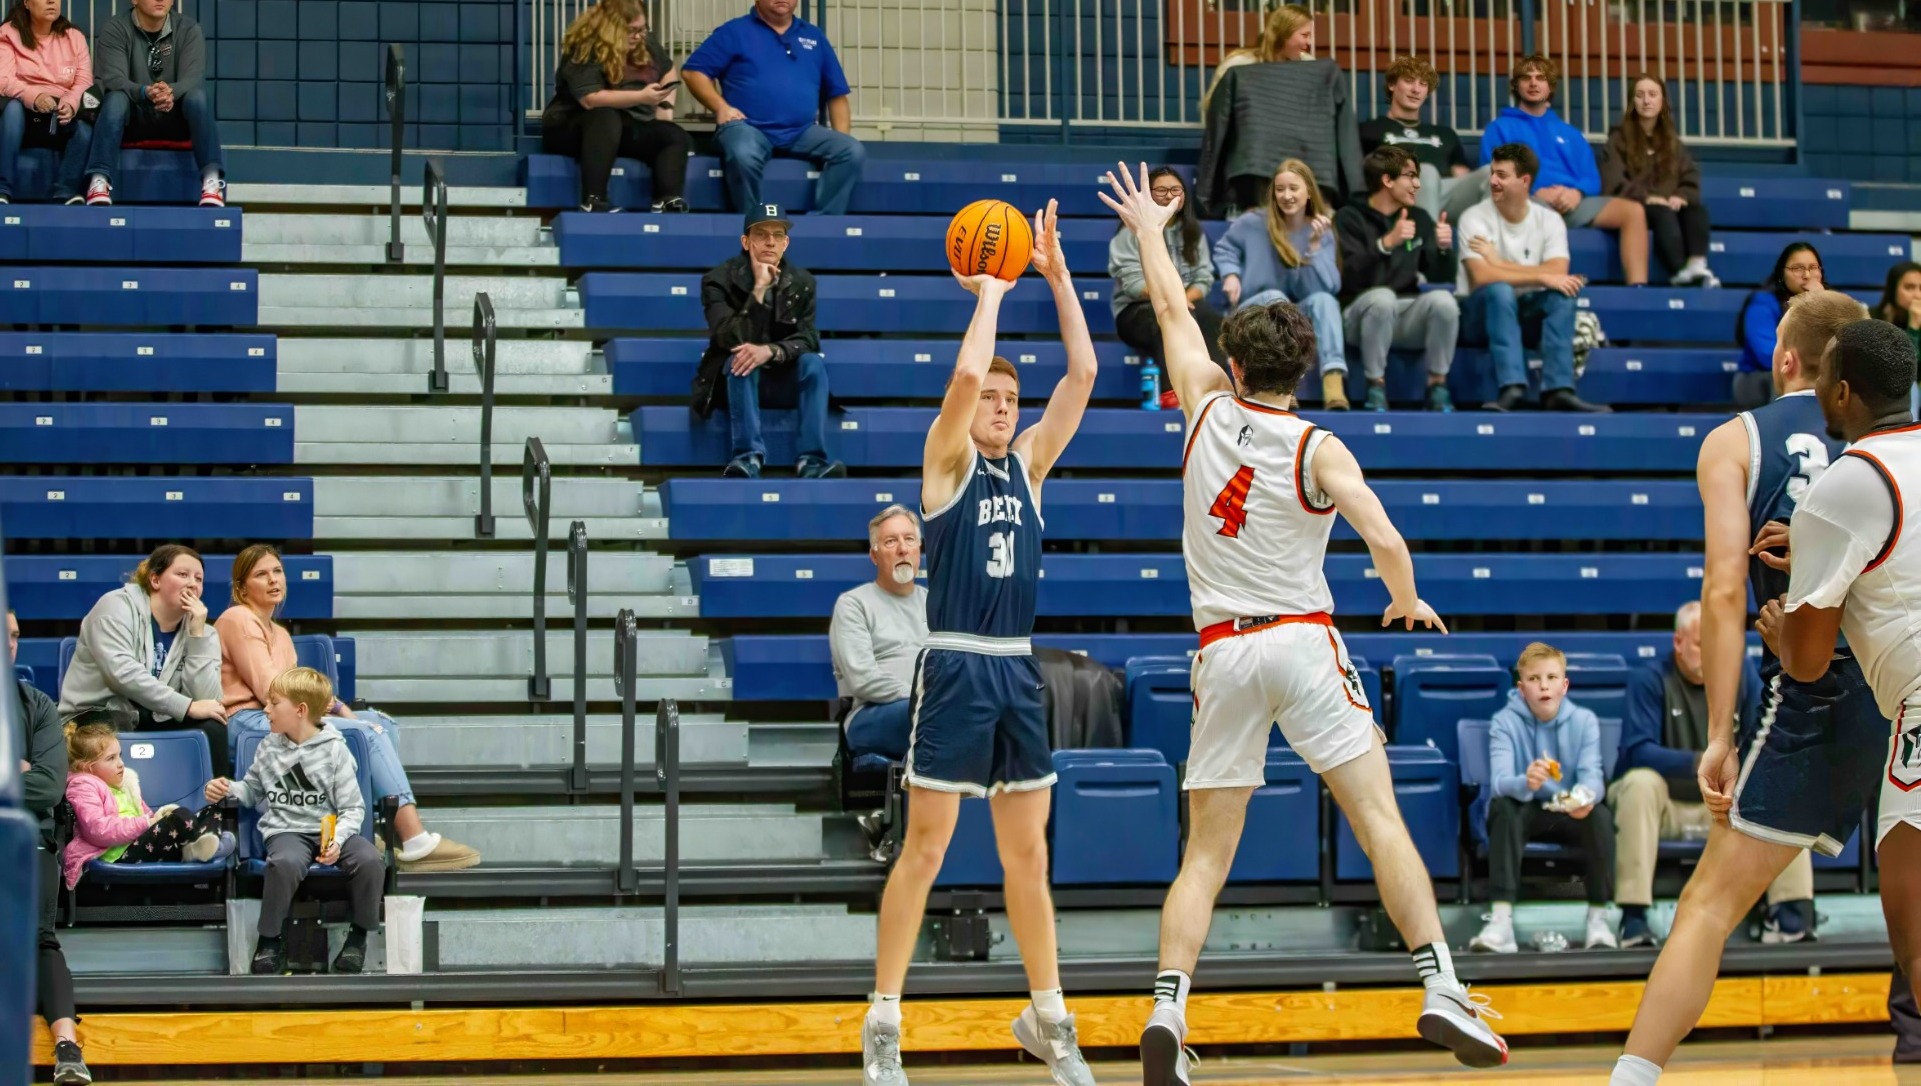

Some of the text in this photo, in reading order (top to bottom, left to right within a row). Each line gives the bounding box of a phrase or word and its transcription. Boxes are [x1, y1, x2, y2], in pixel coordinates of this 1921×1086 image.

[765, 204, 778, 217] B
[1208, 464, 1256, 539] 4
[139, 746, 147, 756] 2
[267, 790, 328, 807] adidas
